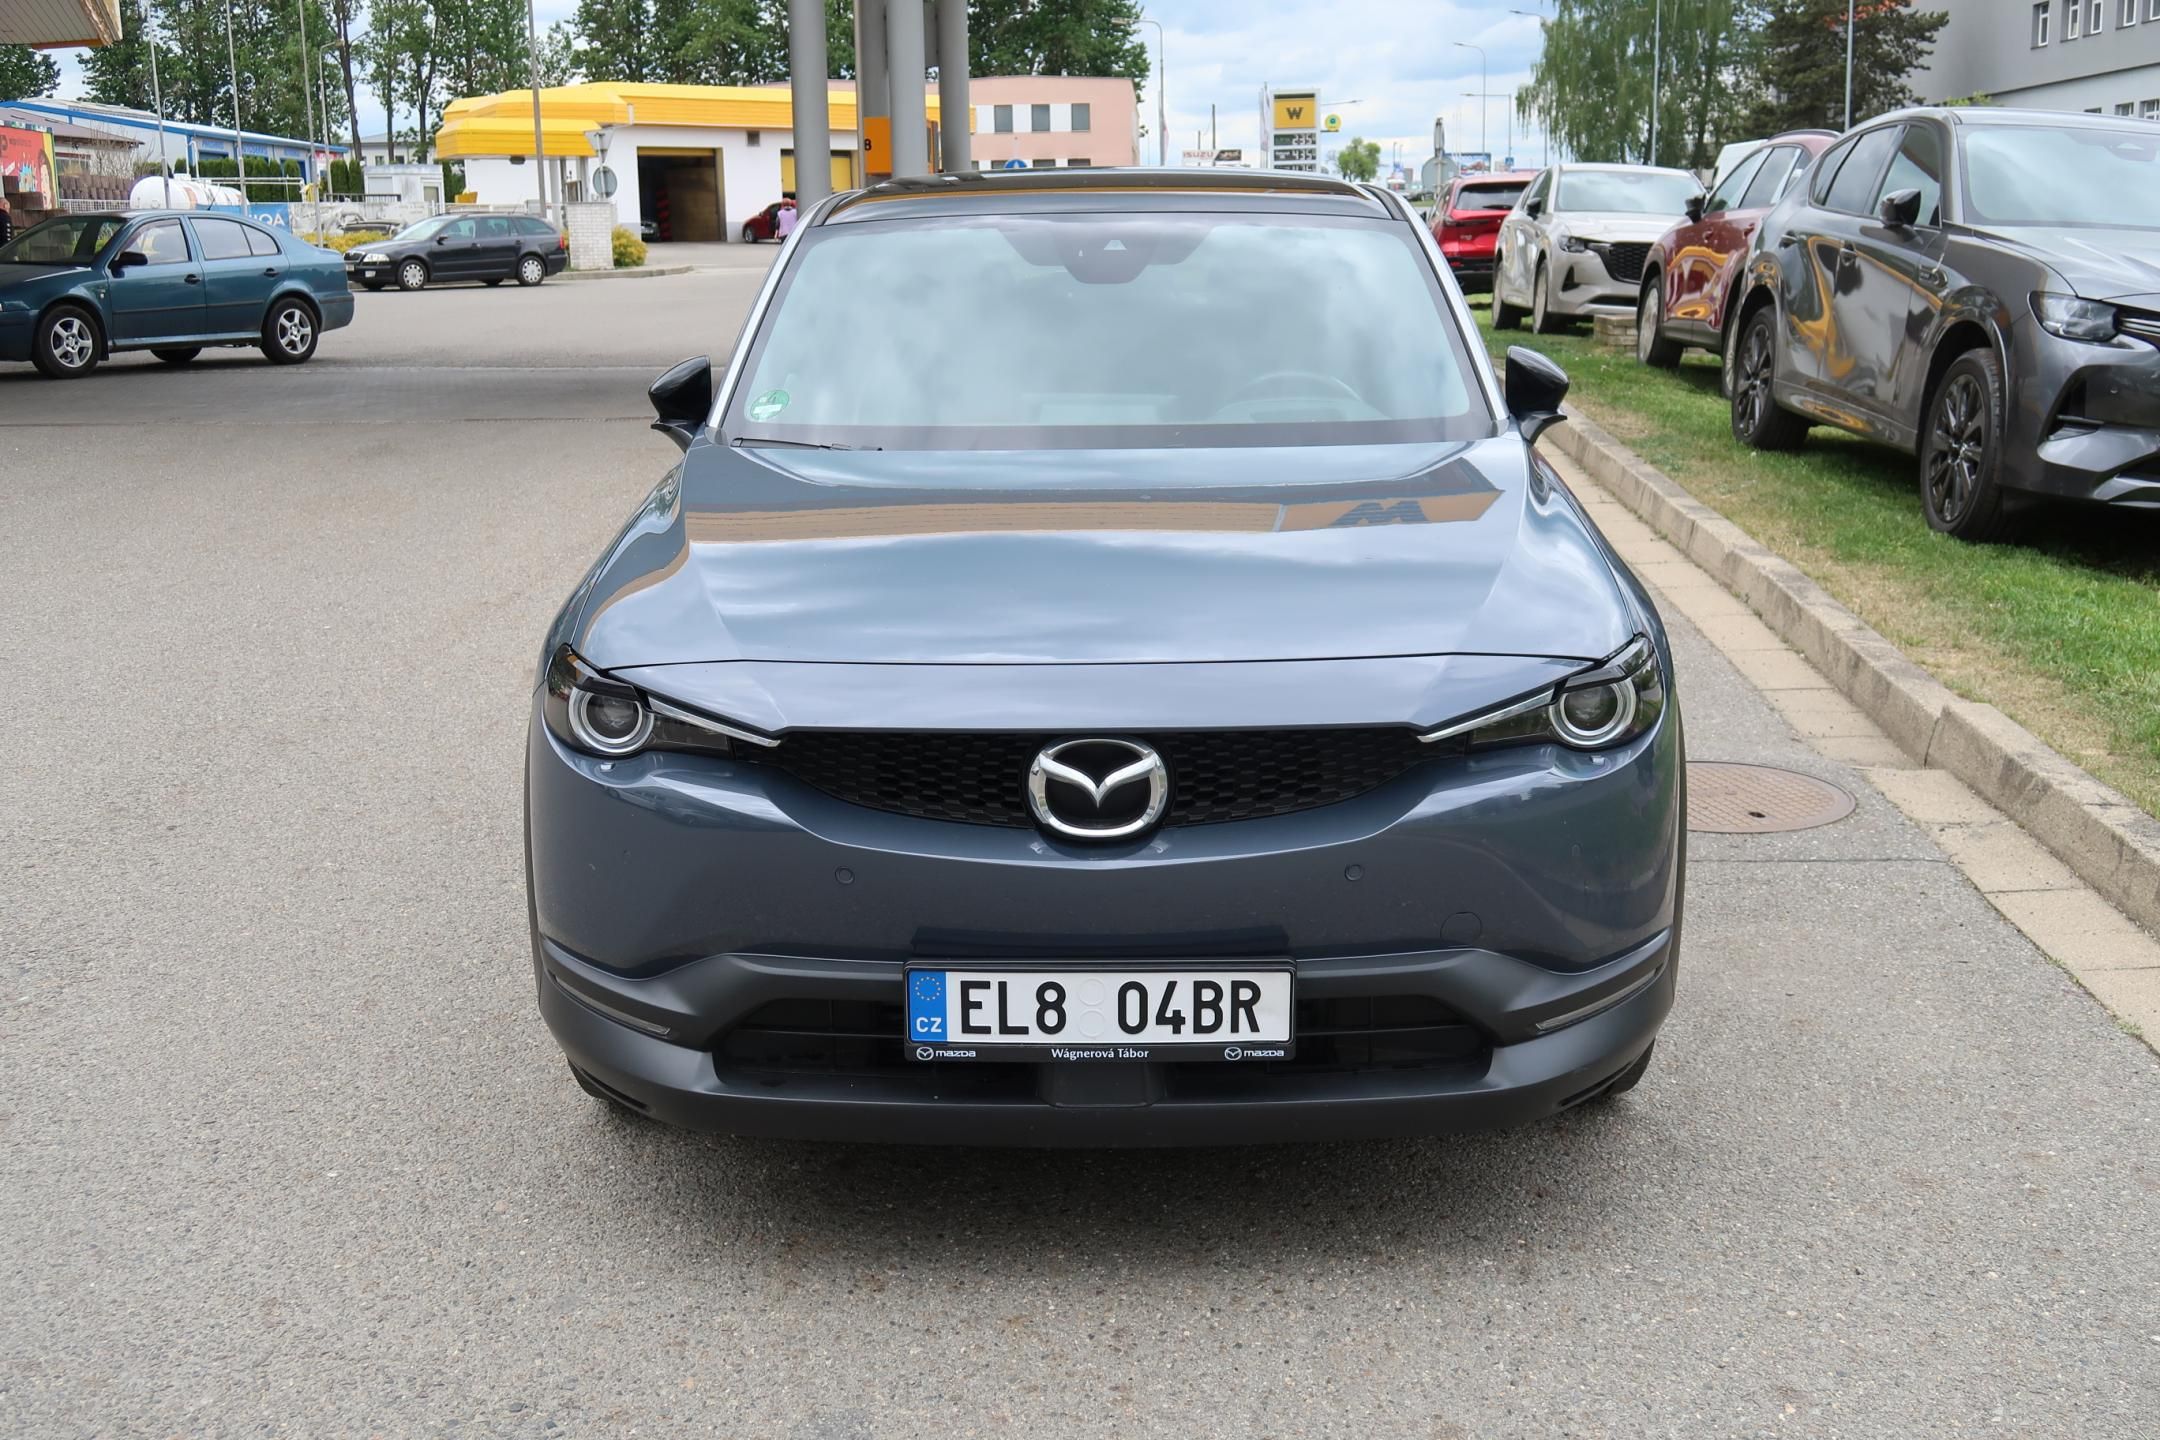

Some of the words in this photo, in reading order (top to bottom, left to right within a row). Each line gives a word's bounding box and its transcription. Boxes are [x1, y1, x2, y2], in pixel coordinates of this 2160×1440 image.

[1286, 107, 1304, 120] W
[1183, 151, 1214, 159] ISUZU
[960, 981, 1067, 1035] EL8
[1117, 980, 1262, 1035] 04BR
[916, 1017, 942, 1032] CZ
[1051, 1048, 1114, 1060] Wágnerová
[1117, 1048, 1149, 1058] Tábor
